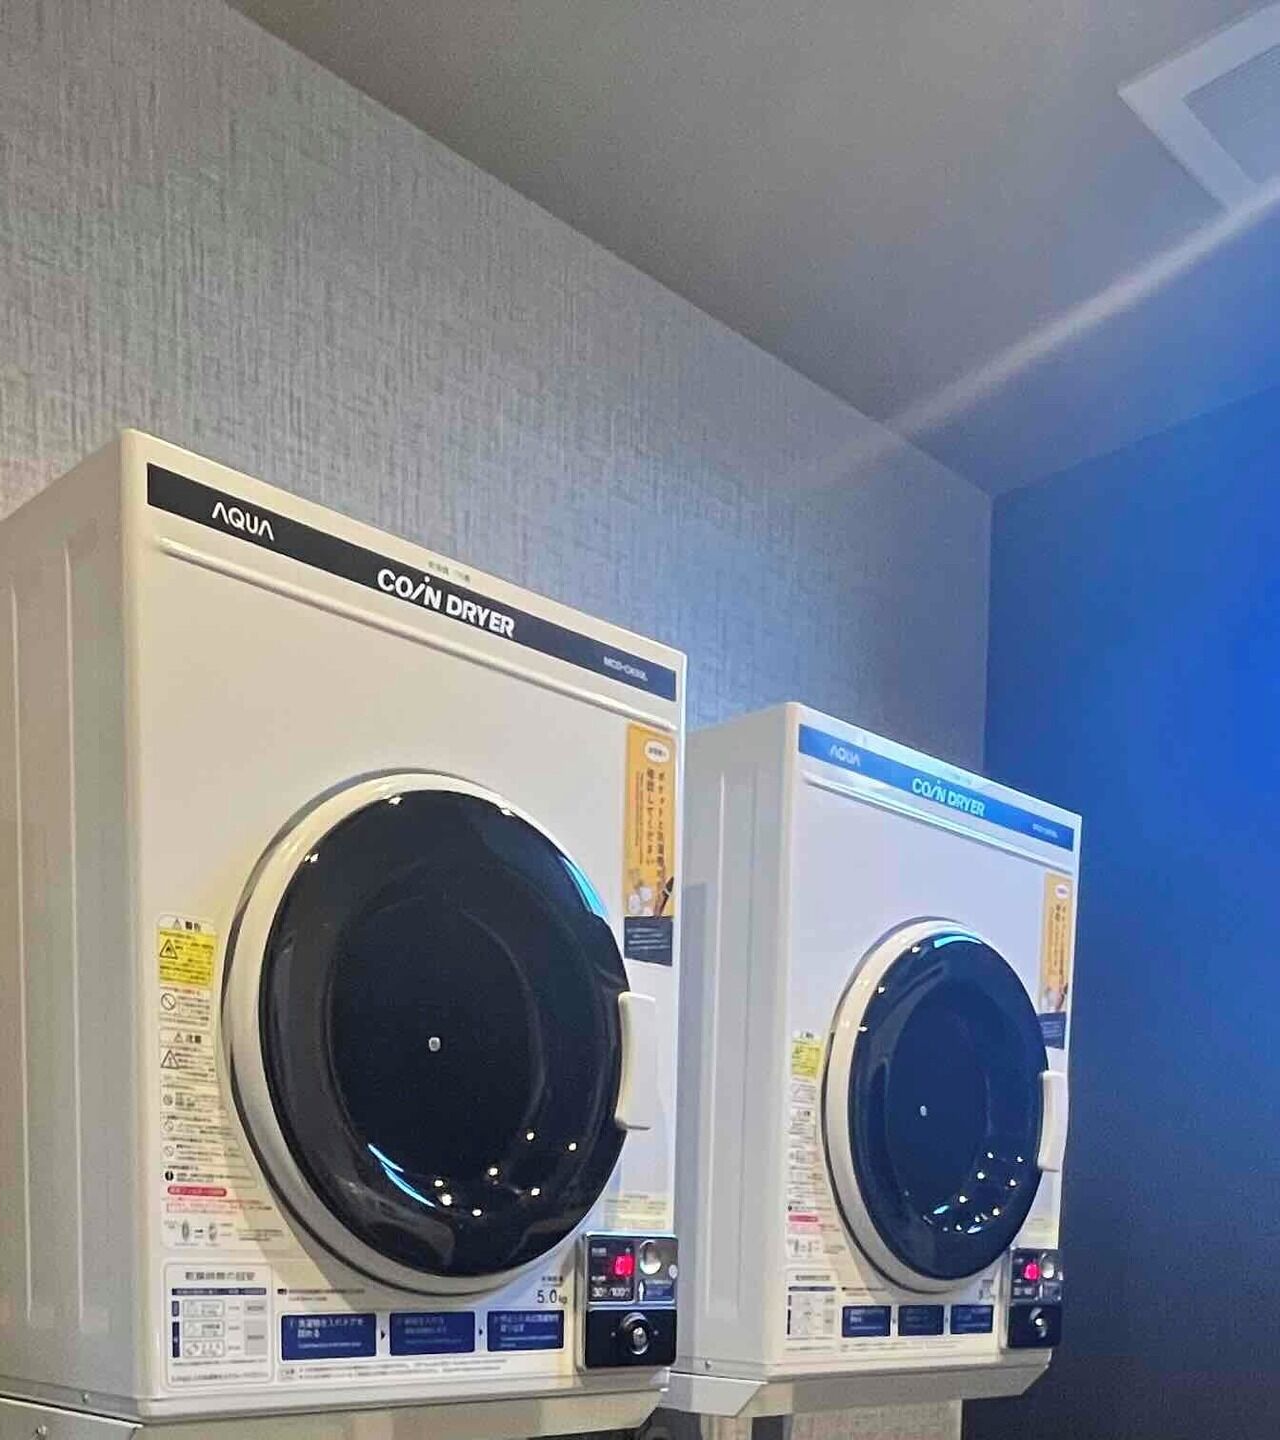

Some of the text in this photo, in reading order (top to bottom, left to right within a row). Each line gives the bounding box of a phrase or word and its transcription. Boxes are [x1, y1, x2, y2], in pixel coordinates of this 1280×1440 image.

[211, 502, 275, 541] AQUA
[446, 597, 516, 638] DRYER
[947, 791, 986, 817] DRYER
[536, 1289, 558, 1304] 5.0
